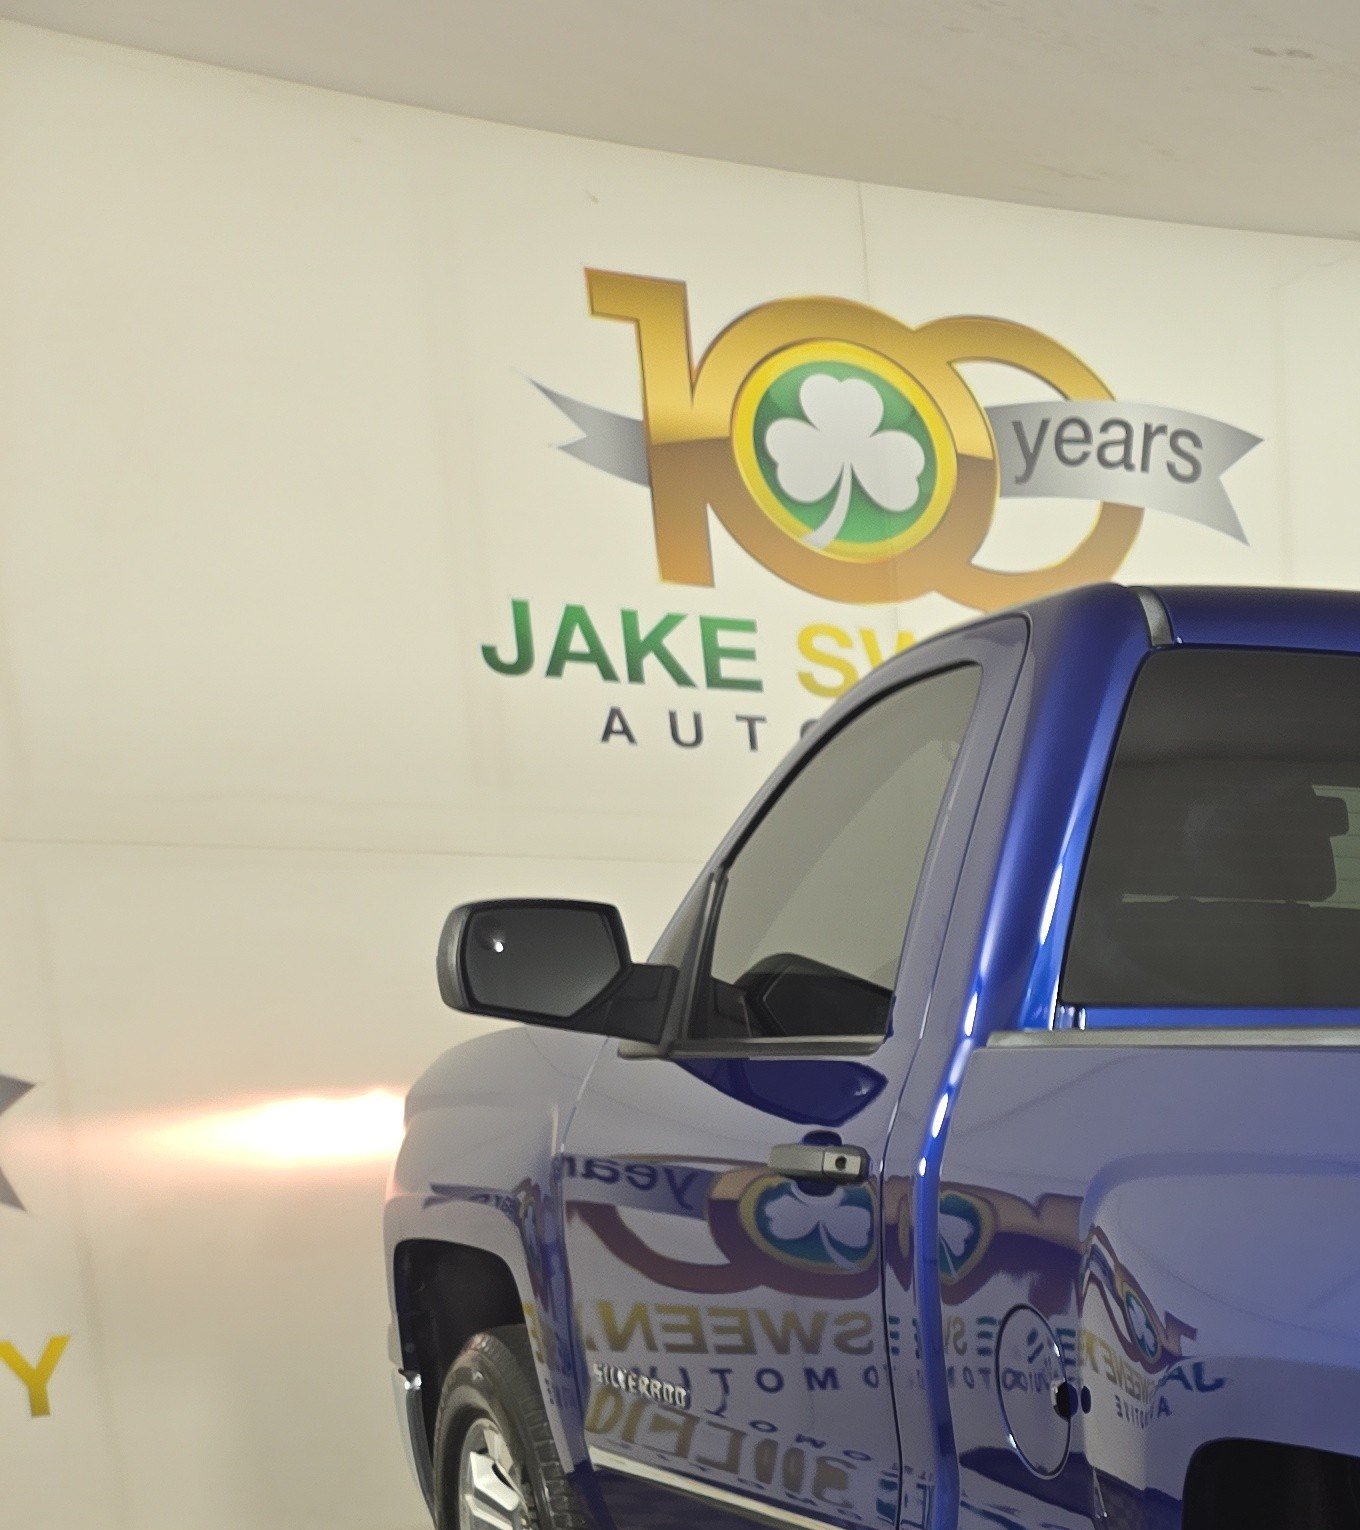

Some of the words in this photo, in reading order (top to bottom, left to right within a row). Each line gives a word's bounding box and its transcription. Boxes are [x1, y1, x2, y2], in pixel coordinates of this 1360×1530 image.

[583, 266, 1146, 612] 100
[1011, 415, 1204, 485] years
[480, 597, 765, 693] JAKE
